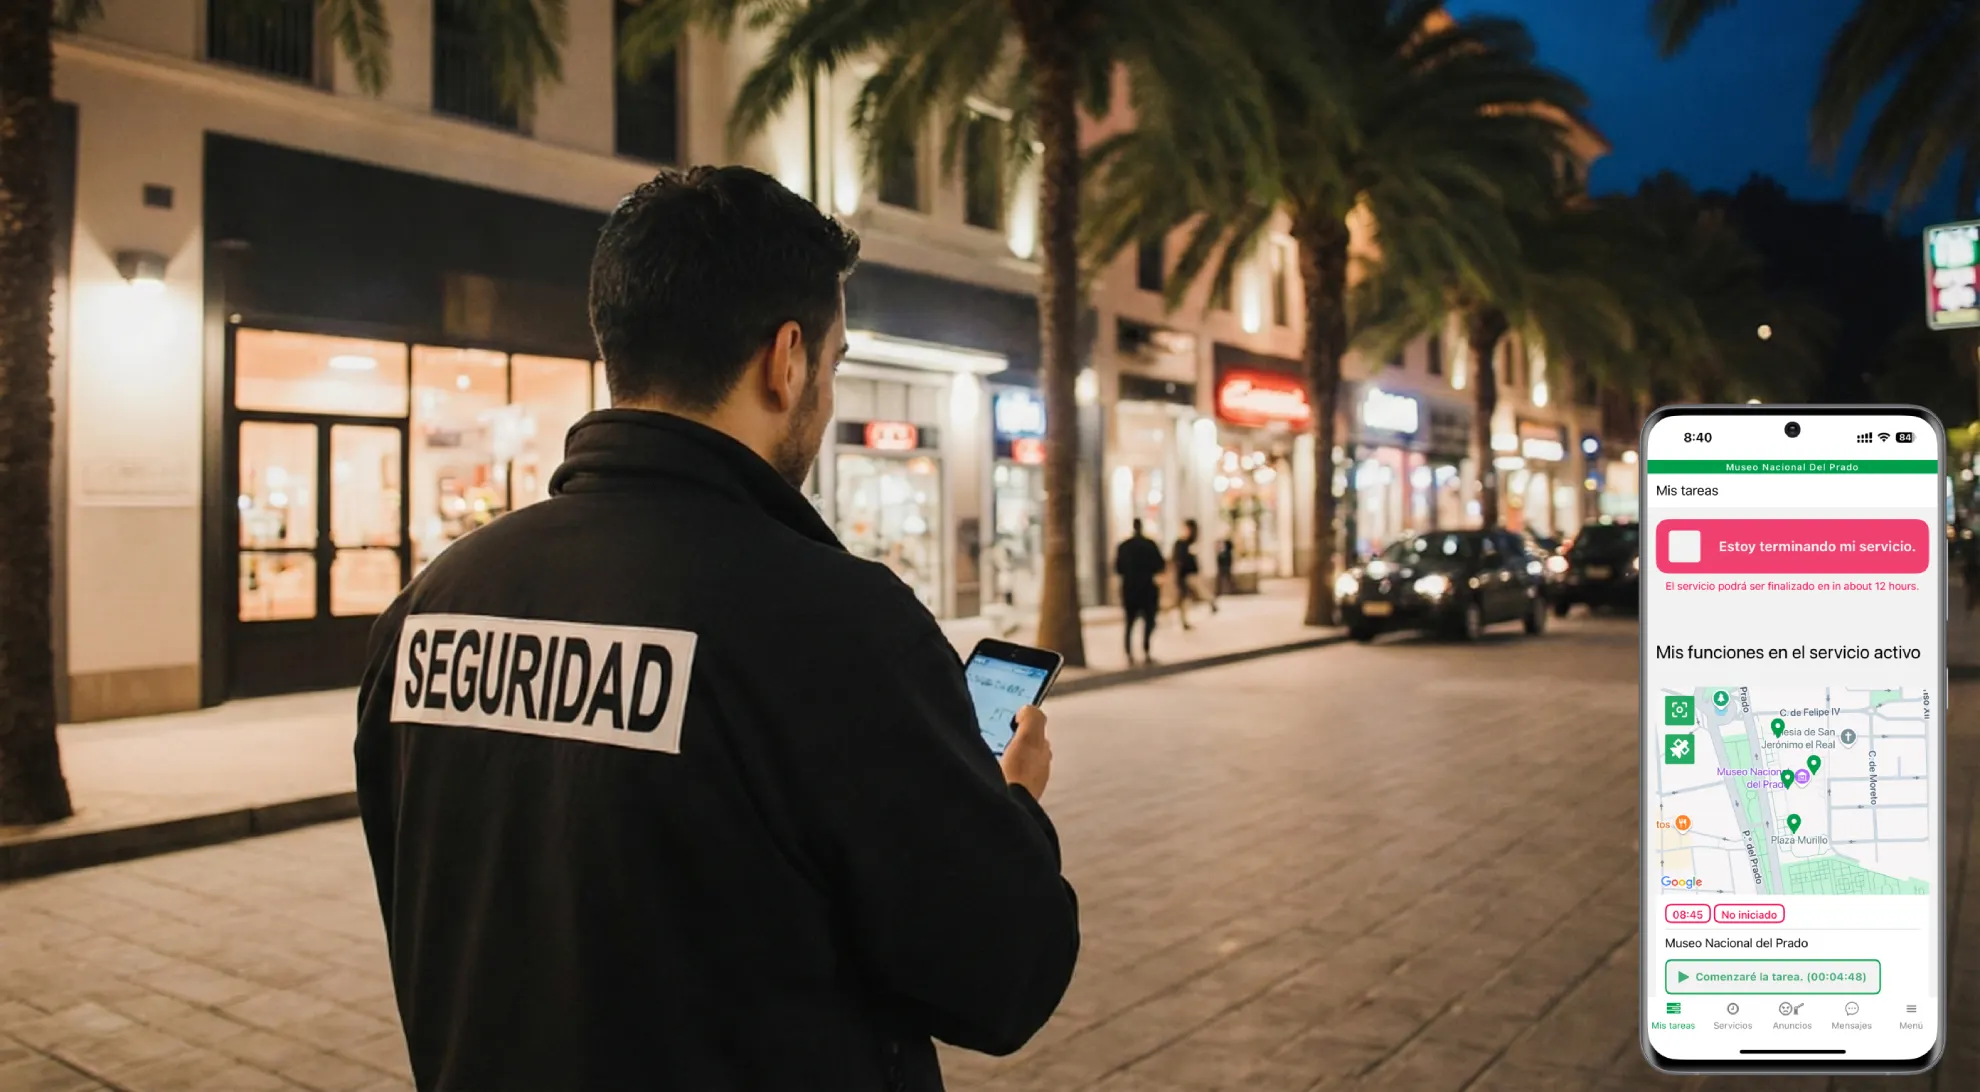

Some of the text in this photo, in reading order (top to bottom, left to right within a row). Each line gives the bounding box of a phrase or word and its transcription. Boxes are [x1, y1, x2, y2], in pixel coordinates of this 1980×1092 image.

[1684, 432, 1712, 443] 8:40
[1657, 485, 1718, 496] Mis tareas
[1719, 541, 1916, 554] Estoy terminando mi servicio.
[1666, 582, 1675, 590] El
[1677, 582, 1715, 590] servicio
[1718, 582, 1746, 592] podrá
[1768, 582, 1815, 590] finalizado
[1832, 582, 1841, 590] in
[1844, 582, 1872, 590] about
[1875, 582, 1885, 590] 12
[1889, 582, 1919, 590] hours.
[1657, 646, 1920, 659] Mis funciones en el servicio activo
[405, 629, 673, 733] SEGURIDAD
[1740, 686, 1749, 712] Prado
[1804, 708, 1829, 717] Felipe
[1869, 750, 1878, 805] C. de Moreto
[1771, 836, 1827, 844] Plaza Murillo
[1746, 844, 1756, 858] del
[1750, 858, 1762, 884] Prado
[1661, 876, 1702, 889] Google
[1673, 910, 1703, 919] 08:45
[1722, 910, 1777, 919] No iniciado
[1665, 938, 1808, 948] Museo Nacional del Prado
[1696, 972, 1866, 983] Comenzaré la tarea. (00:04:48)
[1832, 1022, 1872, 1031] Mensajes
